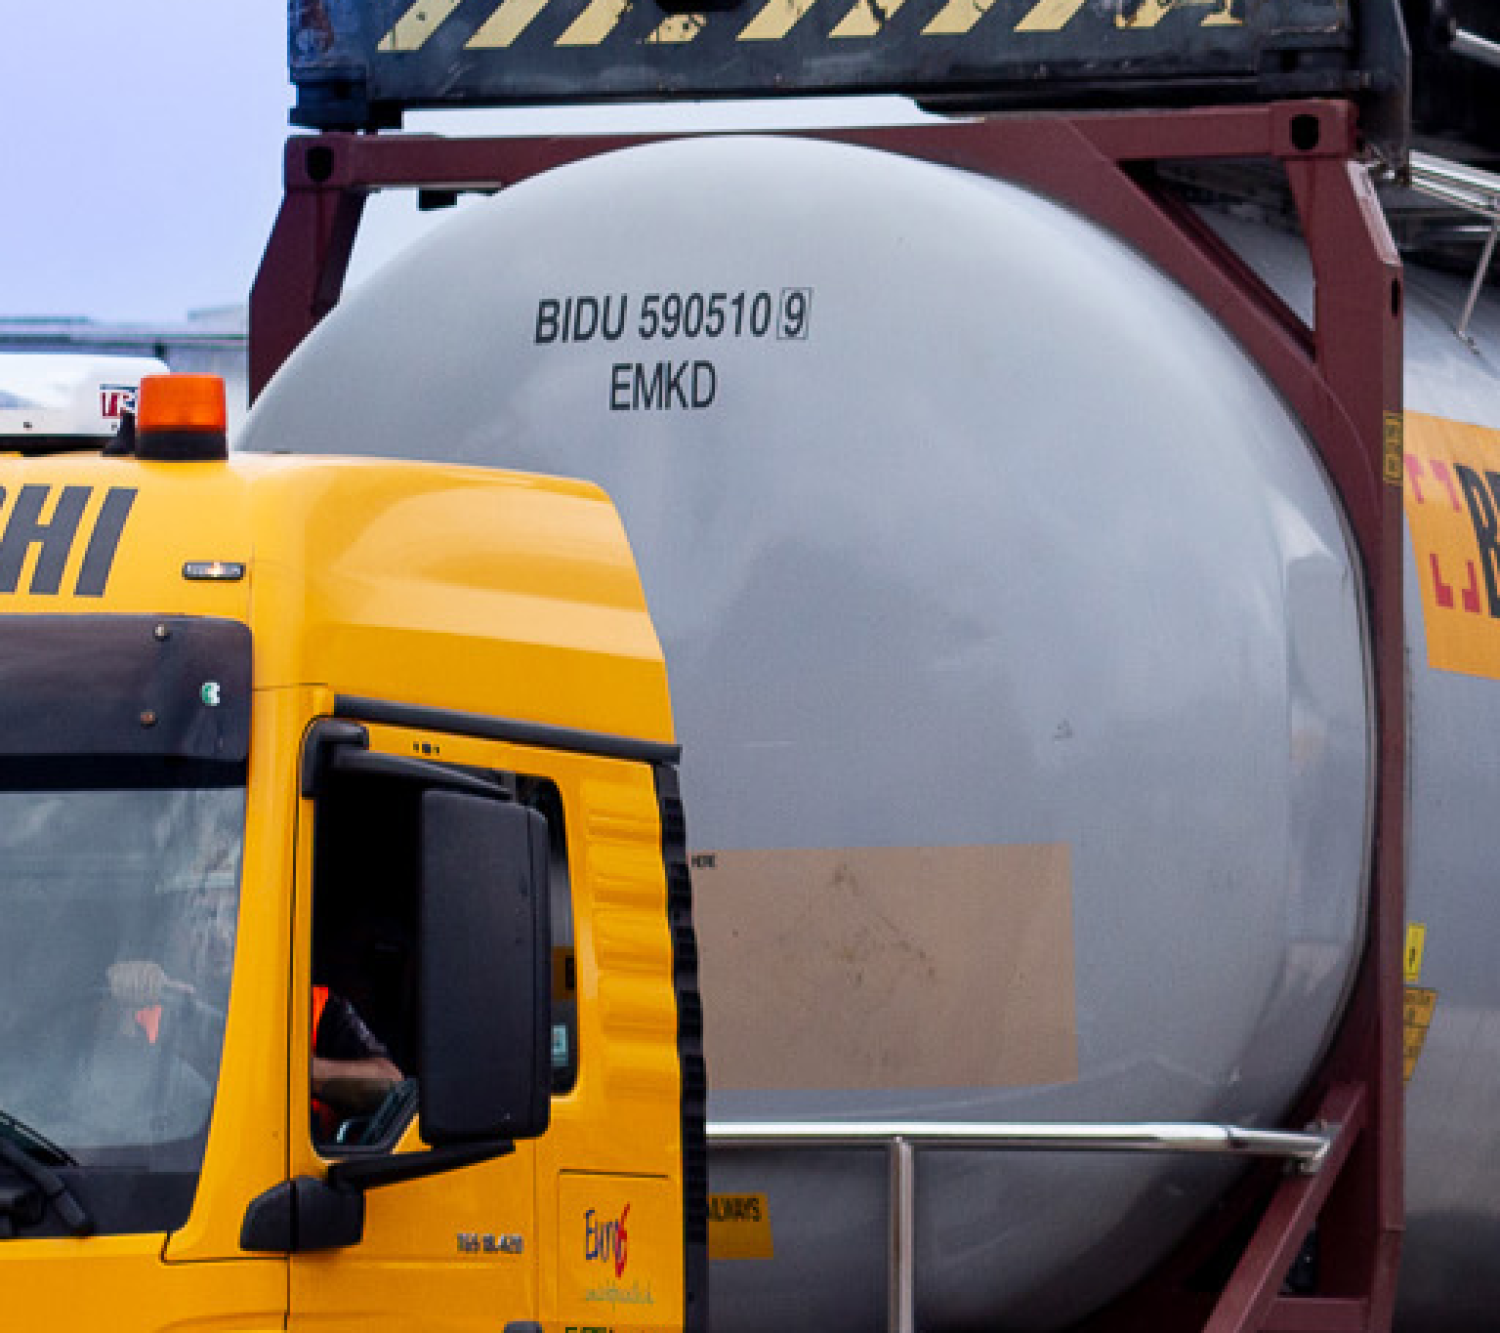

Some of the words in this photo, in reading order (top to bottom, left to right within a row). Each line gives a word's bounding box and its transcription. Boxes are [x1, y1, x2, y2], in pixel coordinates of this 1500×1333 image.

[536, 295, 628, 345] BIDU
[638, 290, 772, 338] 590510
[782, 290, 806, 337] 9
[610, 360, 716, 411] EMKD
